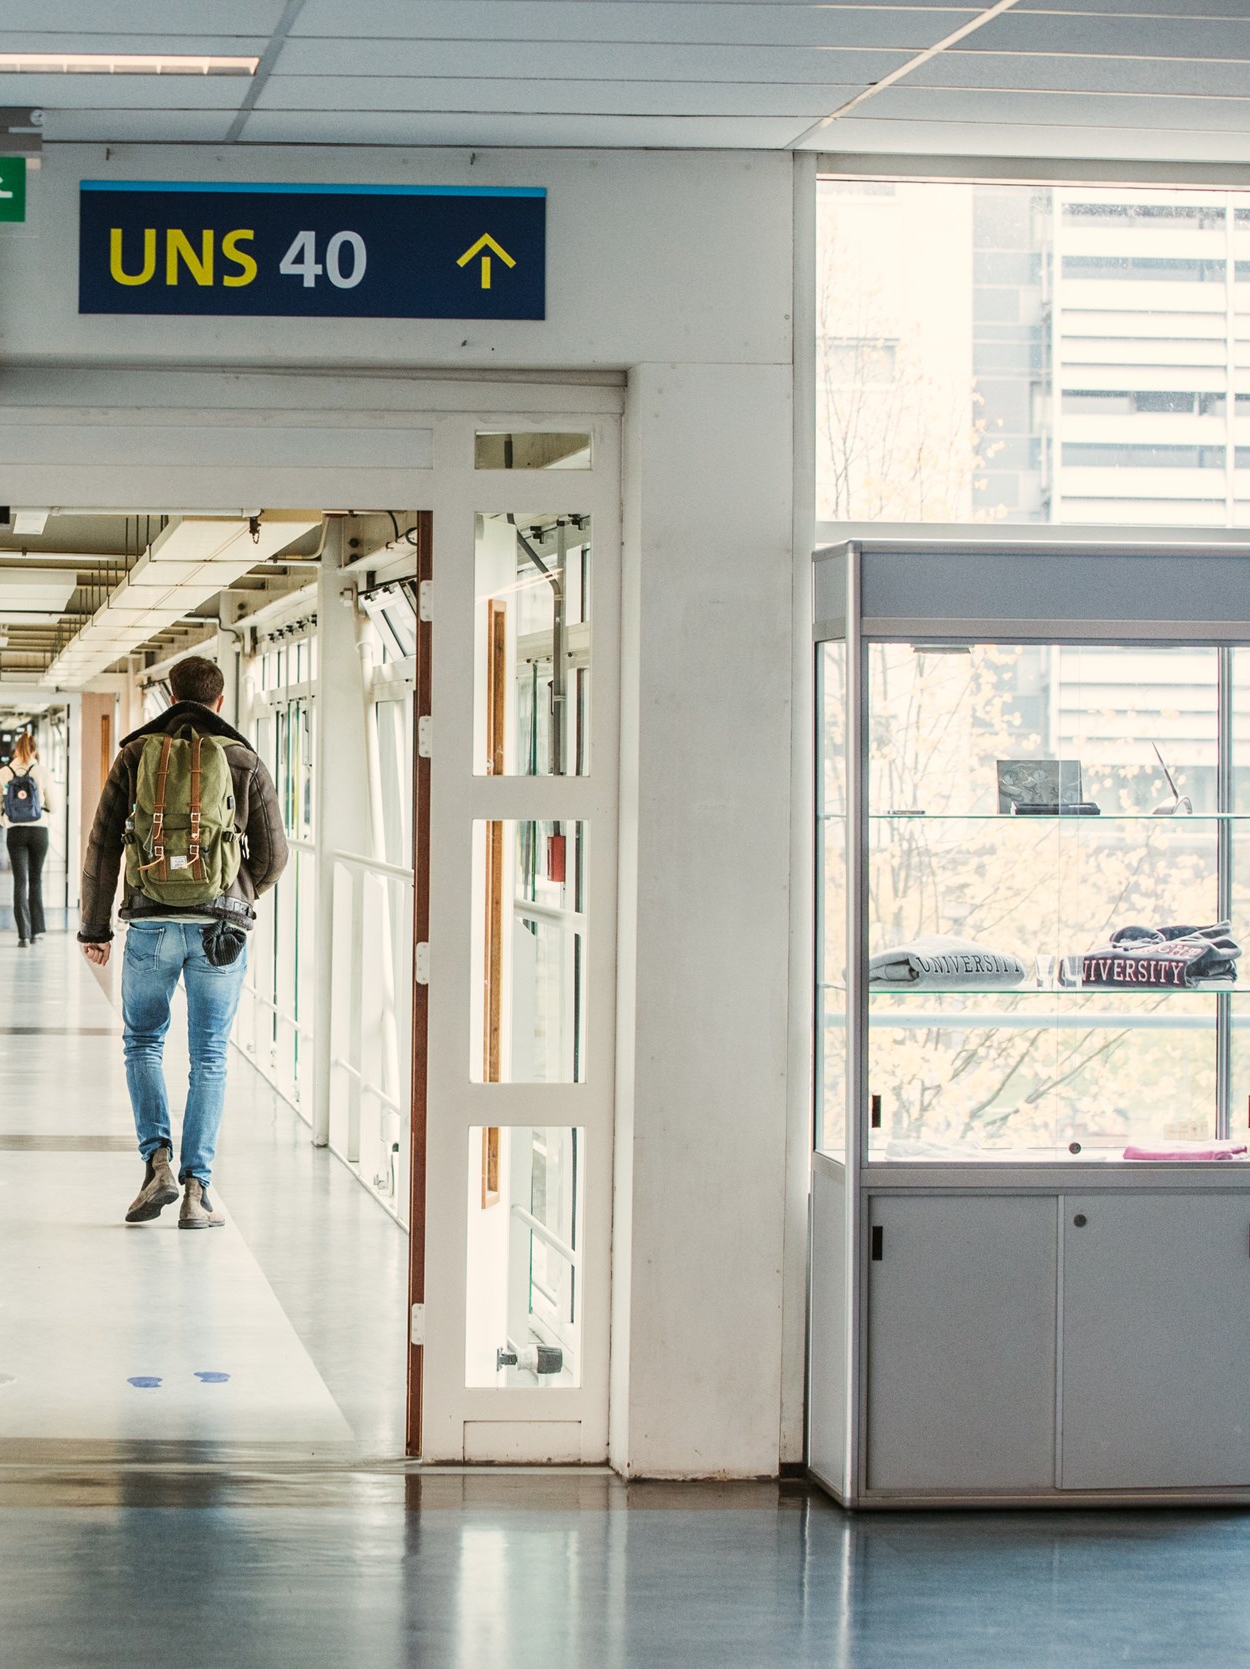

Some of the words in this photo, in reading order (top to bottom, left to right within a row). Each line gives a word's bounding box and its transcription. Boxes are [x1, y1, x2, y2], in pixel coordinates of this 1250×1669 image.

[109, 227, 258, 288] UNS
[279, 230, 368, 290] 40
[1070, 958, 1185, 985] NIVERSITY
